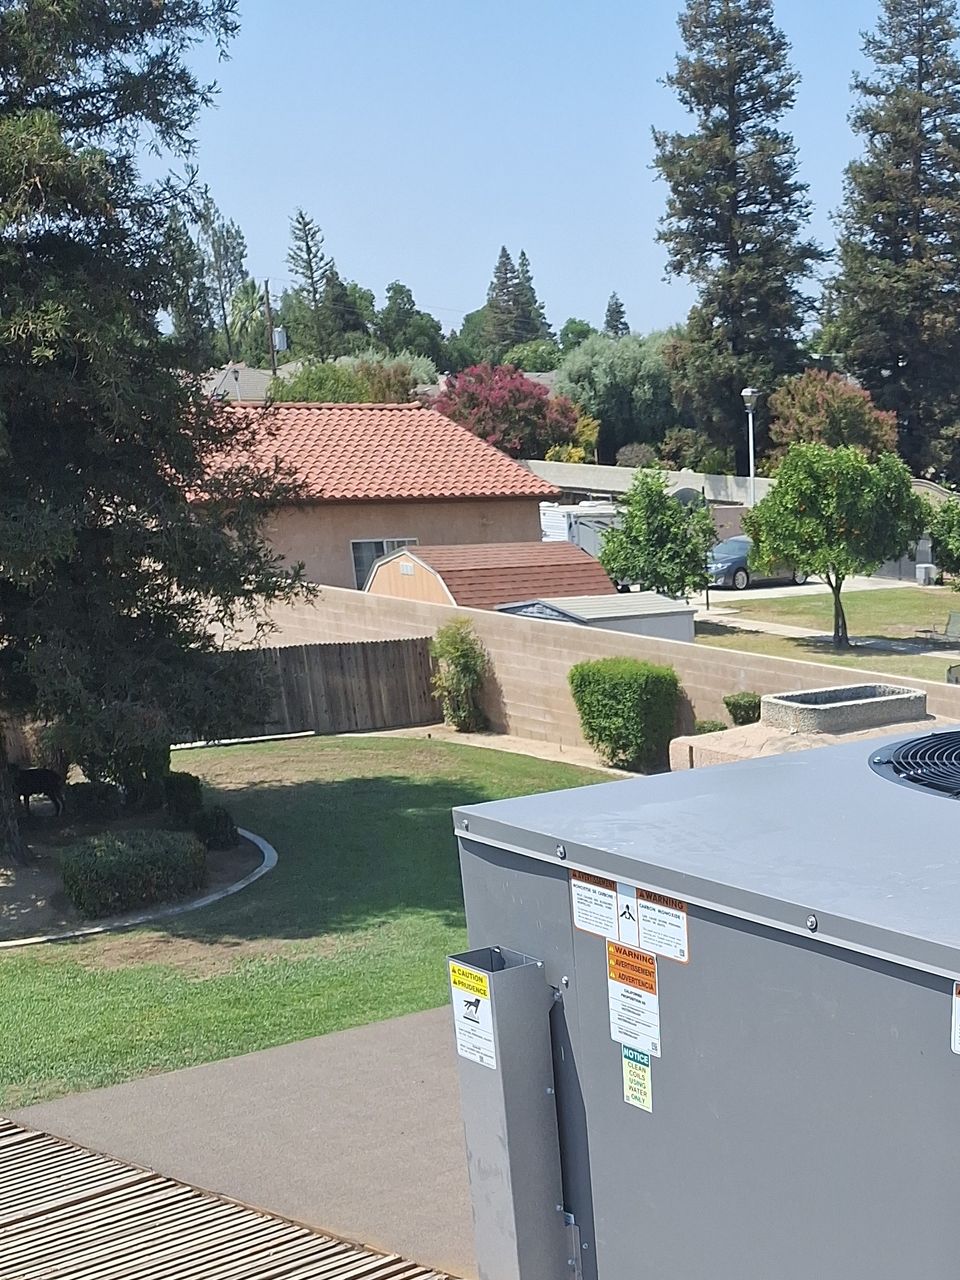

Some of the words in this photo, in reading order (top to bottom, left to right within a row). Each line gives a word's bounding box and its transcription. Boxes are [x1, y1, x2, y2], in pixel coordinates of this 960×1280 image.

[645, 892, 683, 910] WARNING
[614, 946, 654, 965] WARNING
[457, 968, 483, 983] CAUTION
[457, 980, 487, 996] PRUDENCE
[624, 1048, 648, 1064] NOTICE
[628, 1062, 646, 1074] CLEAN
[629, 1070, 645, 1081] COILS
[629, 1078, 646, 1089] USING
[629, 1085, 647, 1097] WATER
